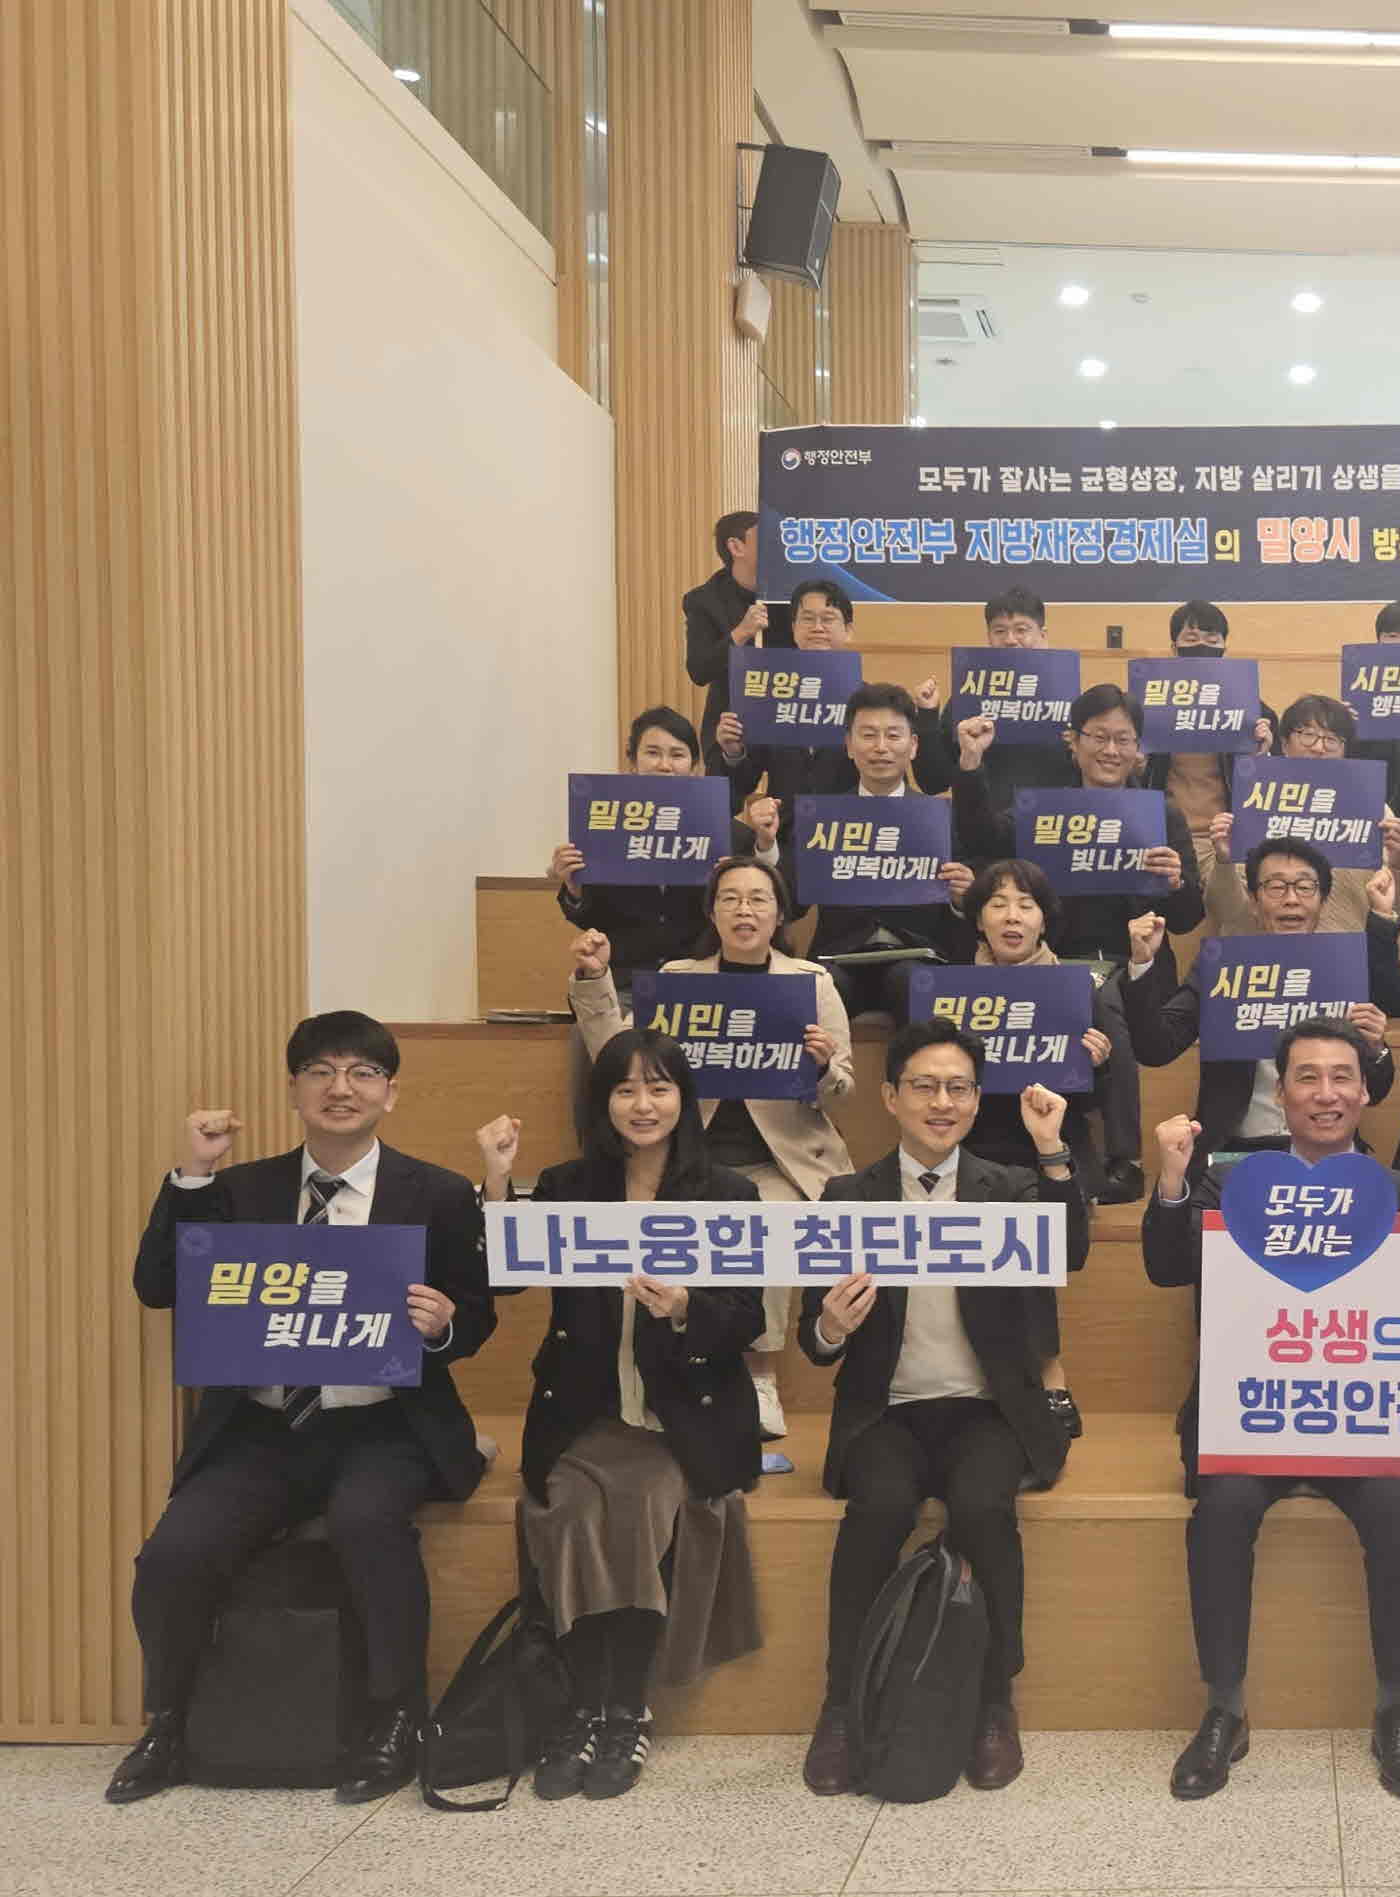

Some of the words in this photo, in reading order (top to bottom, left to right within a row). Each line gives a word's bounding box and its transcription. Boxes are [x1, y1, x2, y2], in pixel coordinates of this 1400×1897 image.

[803, 449, 873, 466] 행정안전부
[918, 466, 990, 493] 모두가
[999, 466, 1073, 493] 잘사는
[1080, 466, 1185, 494] 균형성장,
[1195, 465, 1243, 492] 지방
[1251, 465, 1322, 491] 살리기
[780, 517, 957, 564] 행정안전부
[1256, 516, 1361, 563] 밀양시
[744, 670, 822, 699] 밀양을
[960, 669, 1039, 697] 시민을
[1143, 680, 1220, 706] 밀양을
[776, 702, 848, 725] 빛나게
[980, 699, 1072, 722] 행복하게!
[1175, 709, 1245, 731] 빛나게
[1242, 782, 1336, 814] 시민을
[588, 800, 682, 831] 밀양을
[1033, 814, 1122, 845] 밀양을
[1265, 815, 1373, 844] 행복하게!
[626, 835, 711, 860] 빛나게
[806, 821, 900, 851] 시민을
[831, 855, 938, 880] 행복하게!
[1070, 848, 1146, 872] 빛나게
[1210, 964, 1312, 999] 시민을
[648, 1003, 756, 1037] 시민을
[1264, 1184, 1355, 1218] 모두가
[503, 1214, 769, 1275] 나노융합
[793, 1214, 1051, 1276] 첨단도시
[1263, 1224, 1353, 1257] 잘사는
[207, 1262, 349, 1306] 밀양을
[263, 1312, 392, 1348] 빛나게
